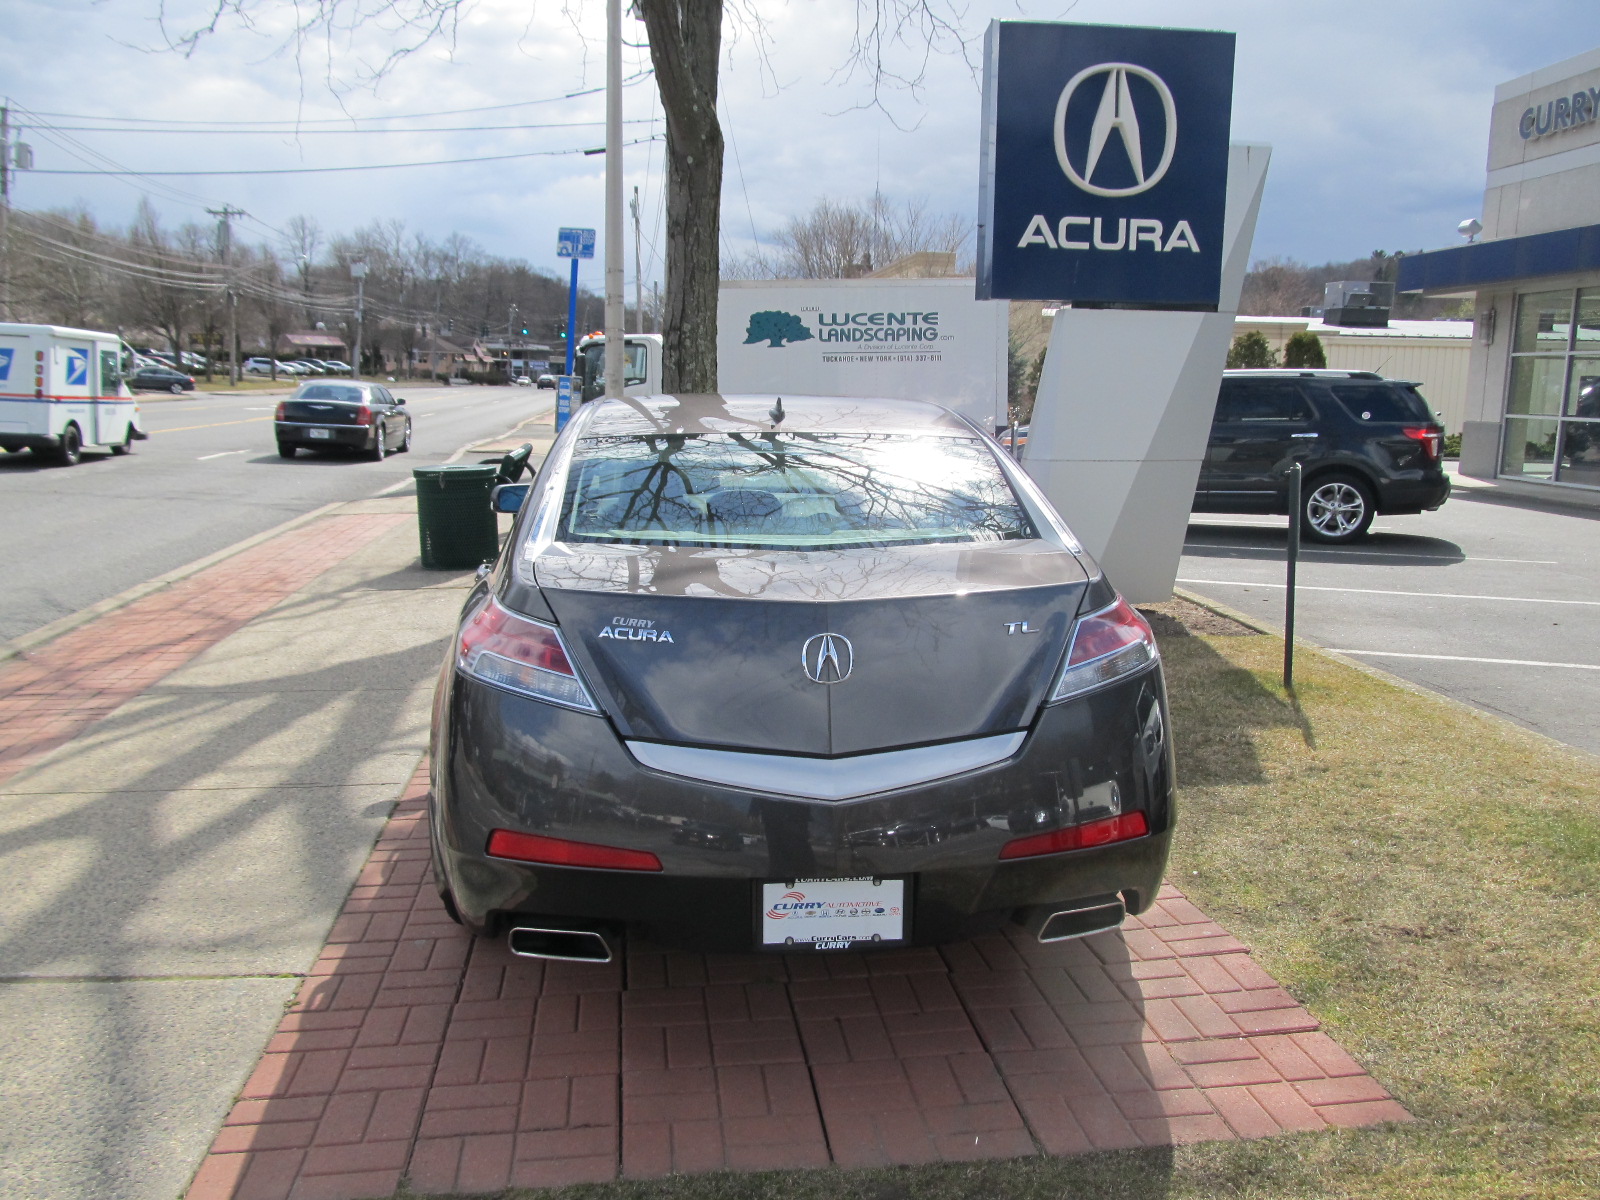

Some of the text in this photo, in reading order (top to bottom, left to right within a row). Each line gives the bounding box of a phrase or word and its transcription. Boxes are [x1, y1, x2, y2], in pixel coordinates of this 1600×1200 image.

[1518, 86, 1600, 140] CURRY
[1016, 214, 1201, 253] ACURA
[818, 311, 939, 327] LUCENTE
[822, 355, 855, 363] TUCKAHOE
[897, 354, 913, 362] (914)
[612, 616, 655, 629] CURRY
[1003, 621, 1040, 635] TL
[598, 625, 675, 644] ACURA
[773, 900, 883, 911] CURRY AUTOMOTIVE
[815, 940, 852, 950] CURRY
